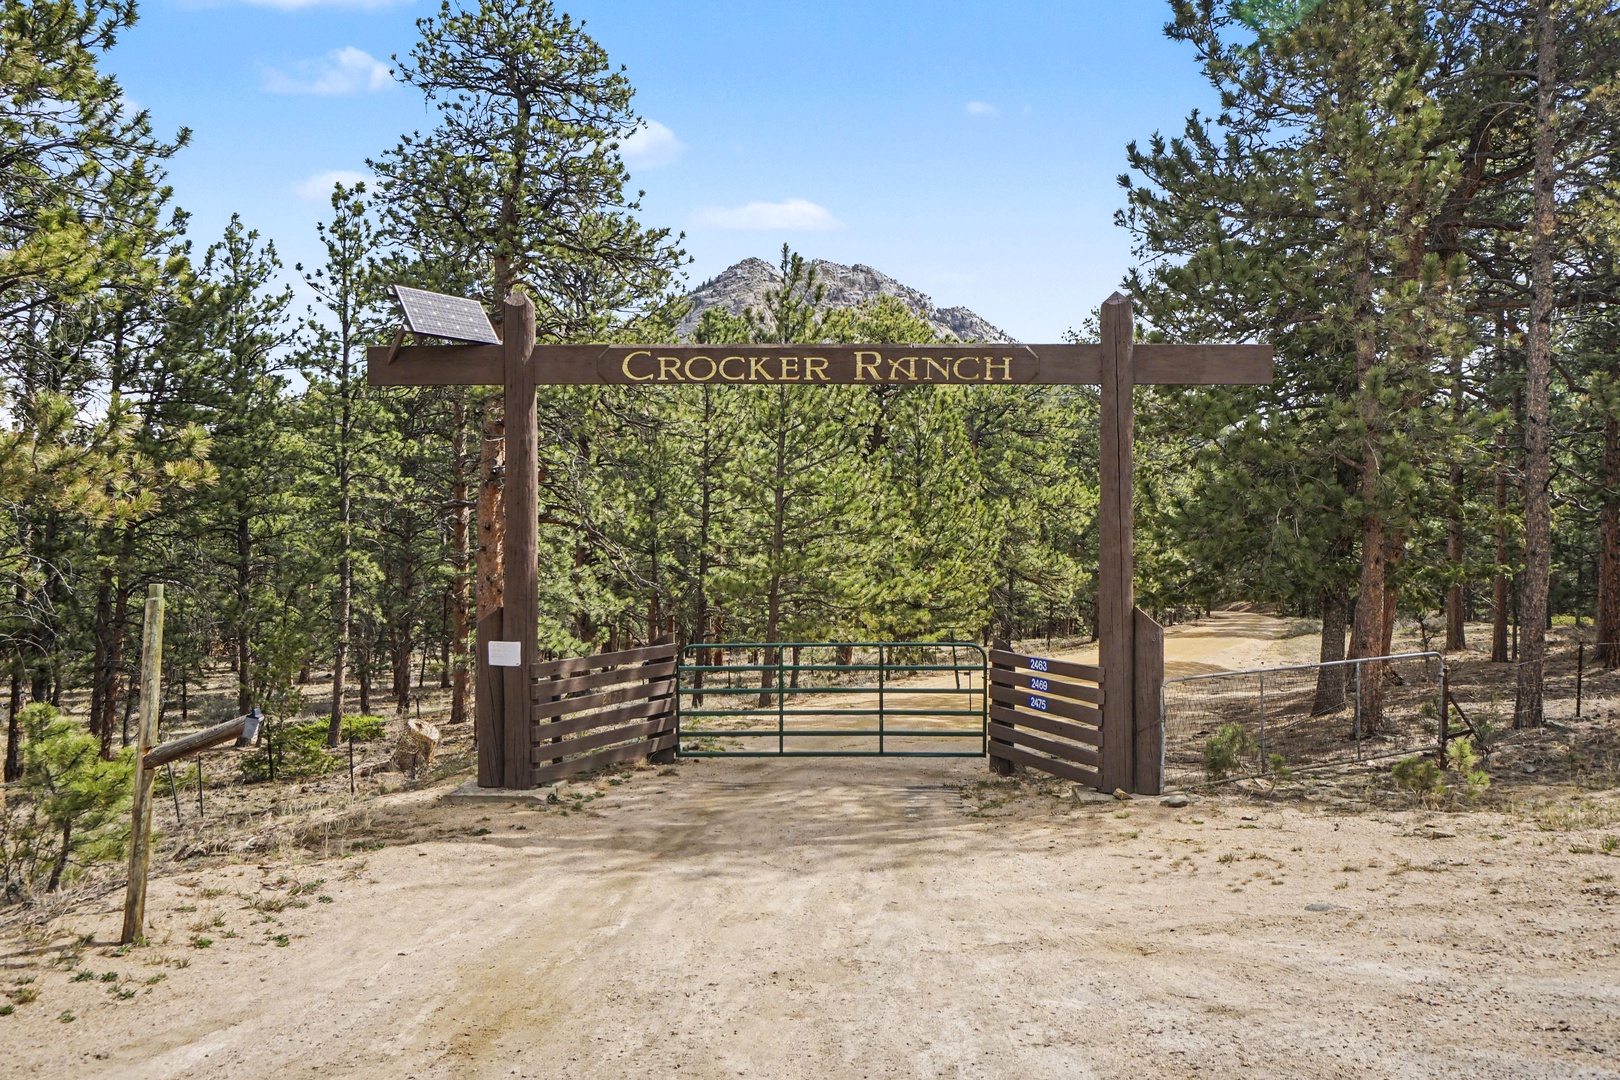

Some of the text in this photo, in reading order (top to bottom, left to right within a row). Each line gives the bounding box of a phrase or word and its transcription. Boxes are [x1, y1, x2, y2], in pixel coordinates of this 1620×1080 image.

[622, 351, 1013, 381] CROCKER RANCH
[1030, 659, 1047, 671] 2463
[1031, 678, 1047, 690] 2469
[1030, 697, 1046, 710] 2475
